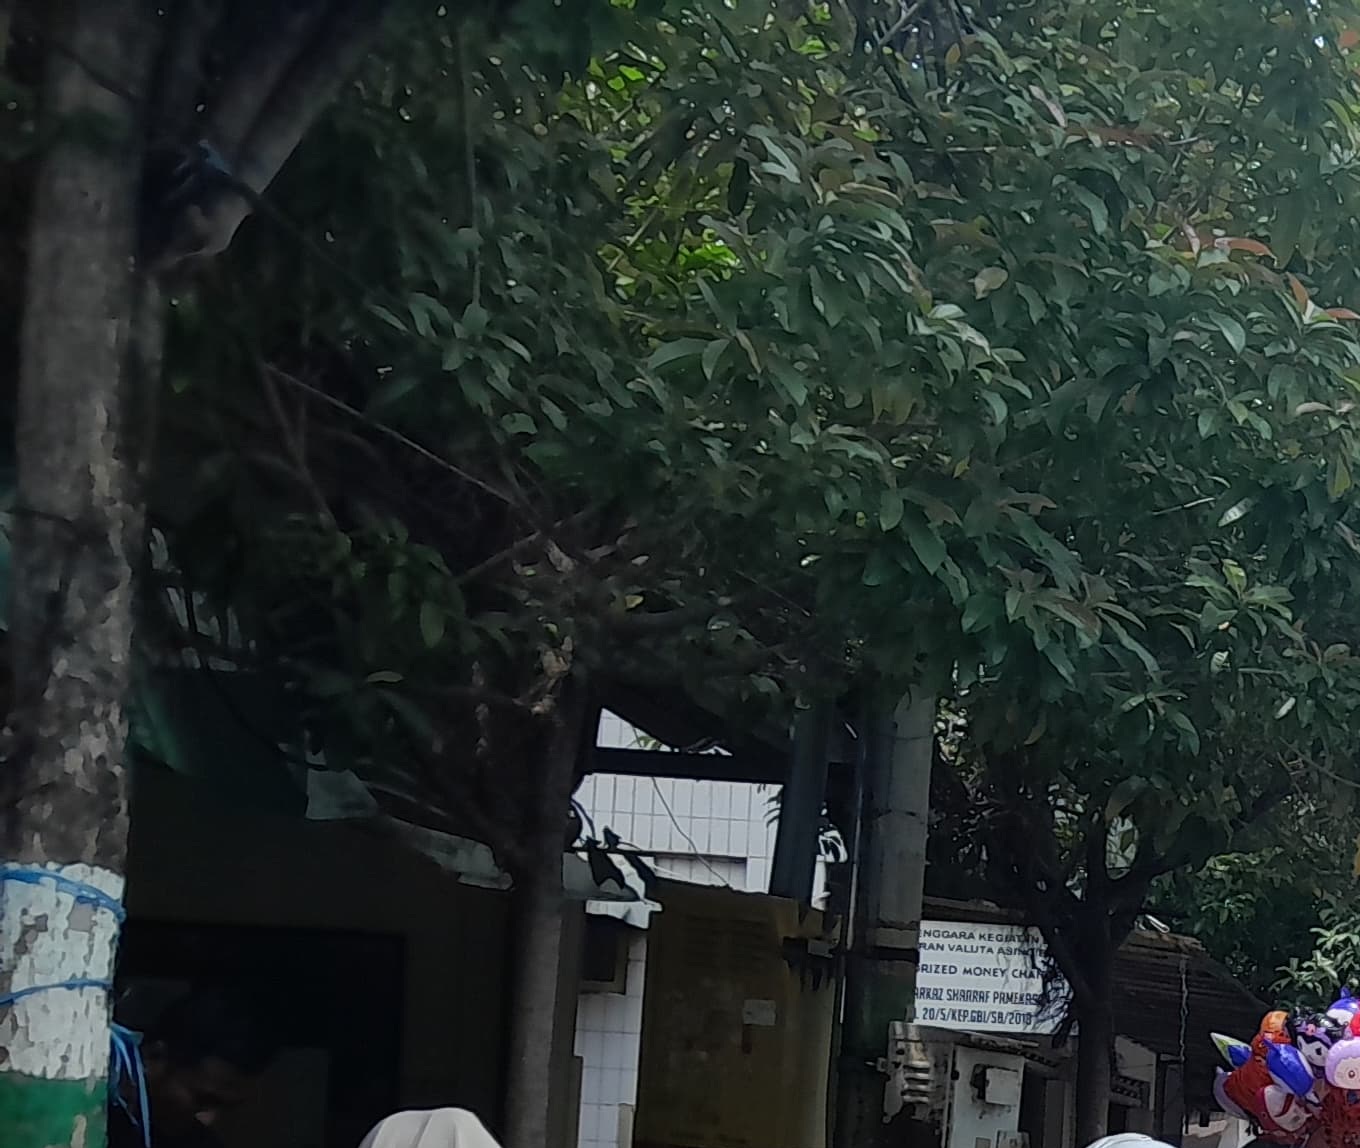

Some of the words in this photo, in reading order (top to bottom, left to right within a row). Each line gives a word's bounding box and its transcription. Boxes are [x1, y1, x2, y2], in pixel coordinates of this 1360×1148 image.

[919, 929, 976, 940] NGGARA
[948, 943, 994, 954] VALUTA
[918, 963, 958, 975] RIZED
[962, 966, 1007, 978] MONEY
